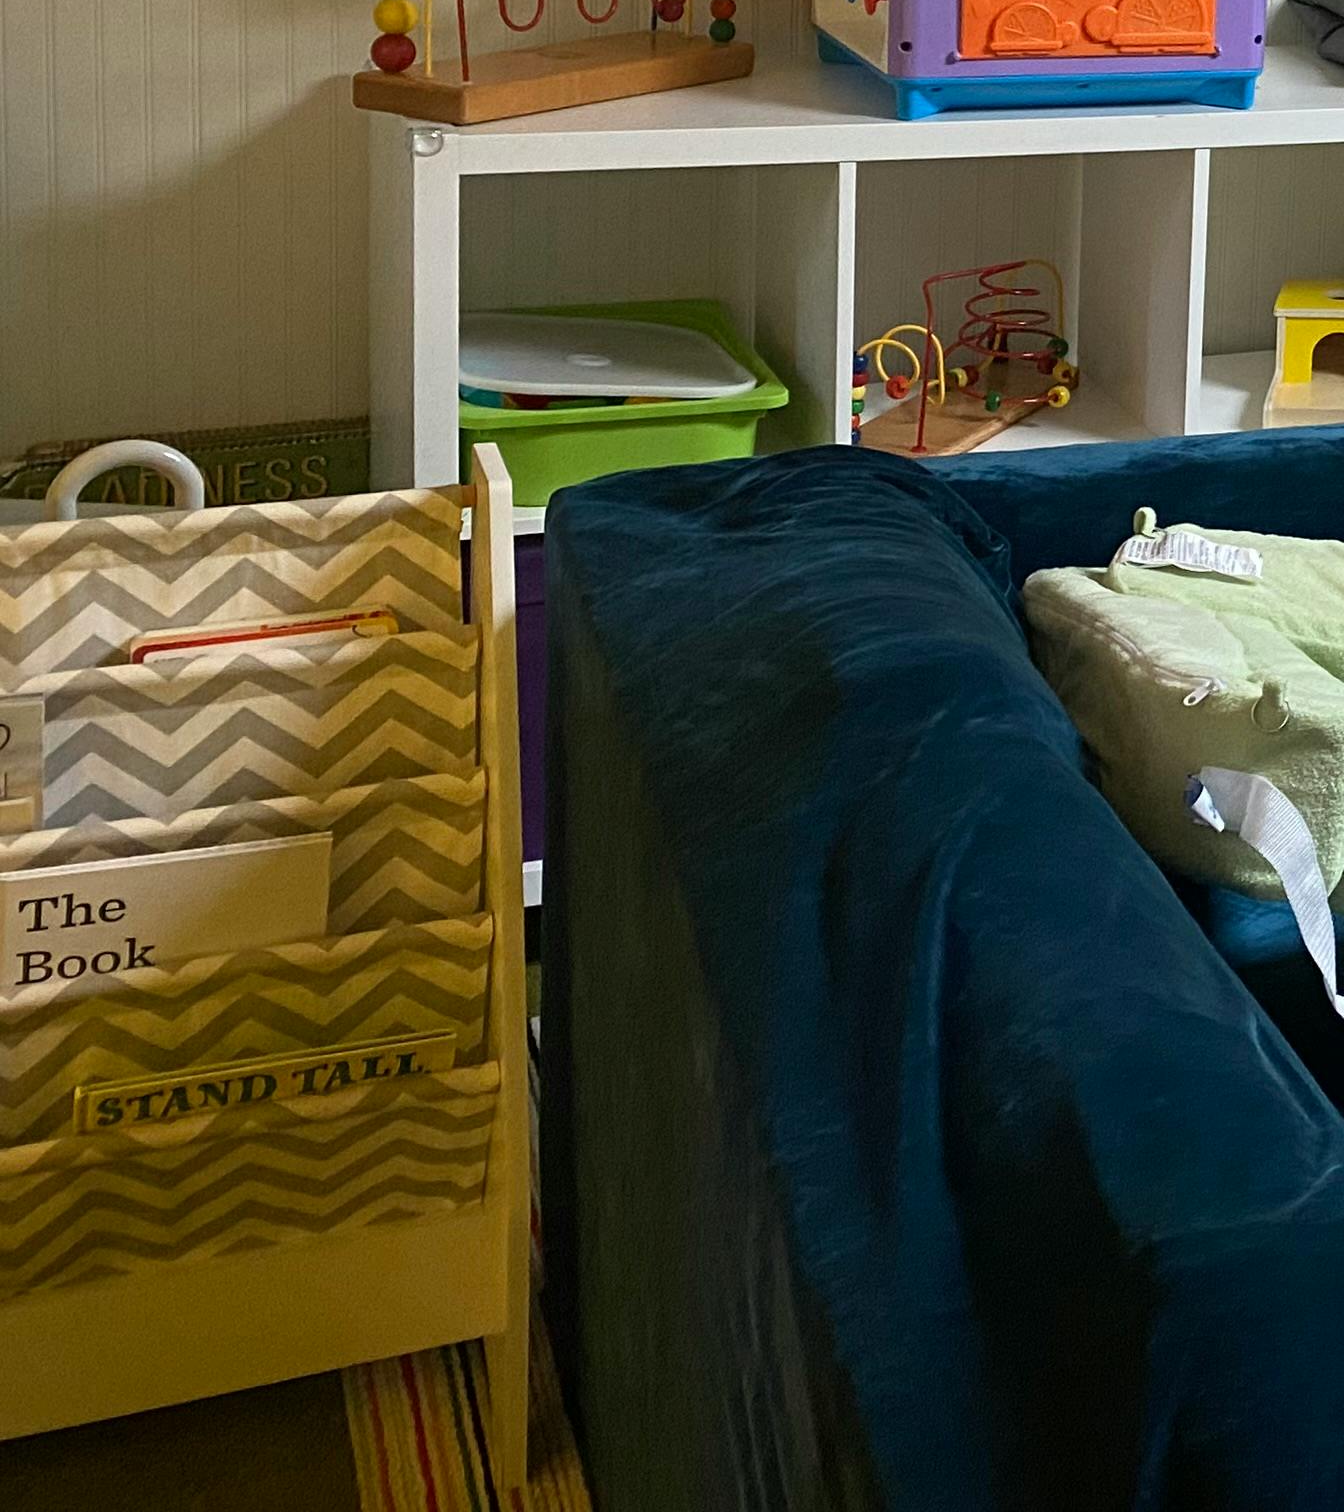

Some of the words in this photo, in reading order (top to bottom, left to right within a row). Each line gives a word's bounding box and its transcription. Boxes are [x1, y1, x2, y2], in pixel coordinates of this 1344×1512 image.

[19, 892, 127, 933] The
[15, 937, 157, 986] Book
[96, 1074, 279, 1127] STAND
